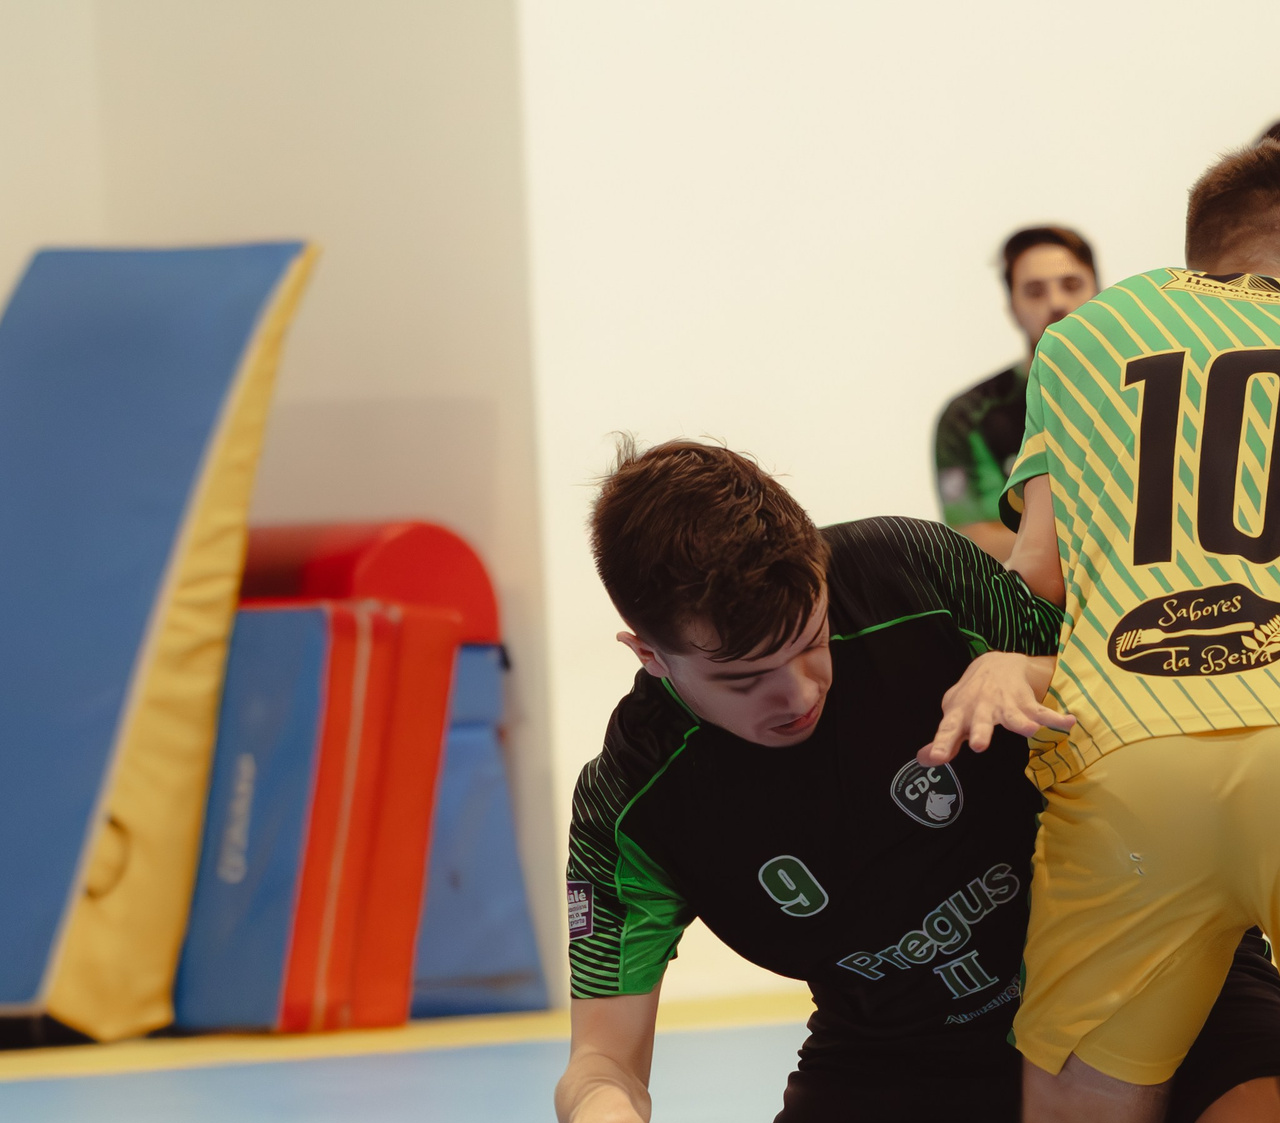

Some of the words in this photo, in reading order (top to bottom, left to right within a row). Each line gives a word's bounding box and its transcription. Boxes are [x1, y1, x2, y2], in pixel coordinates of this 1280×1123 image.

[1158, 595, 1241, 626] Sabores
[1162, 646, 1191, 671] da
[1200, 644, 1273, 674] Beira
[905, 767, 941, 801] CDC
[758, 855, 829, 917] 9
[836, 863, 1020, 980] Pregus
[932, 950, 999, 999] II
